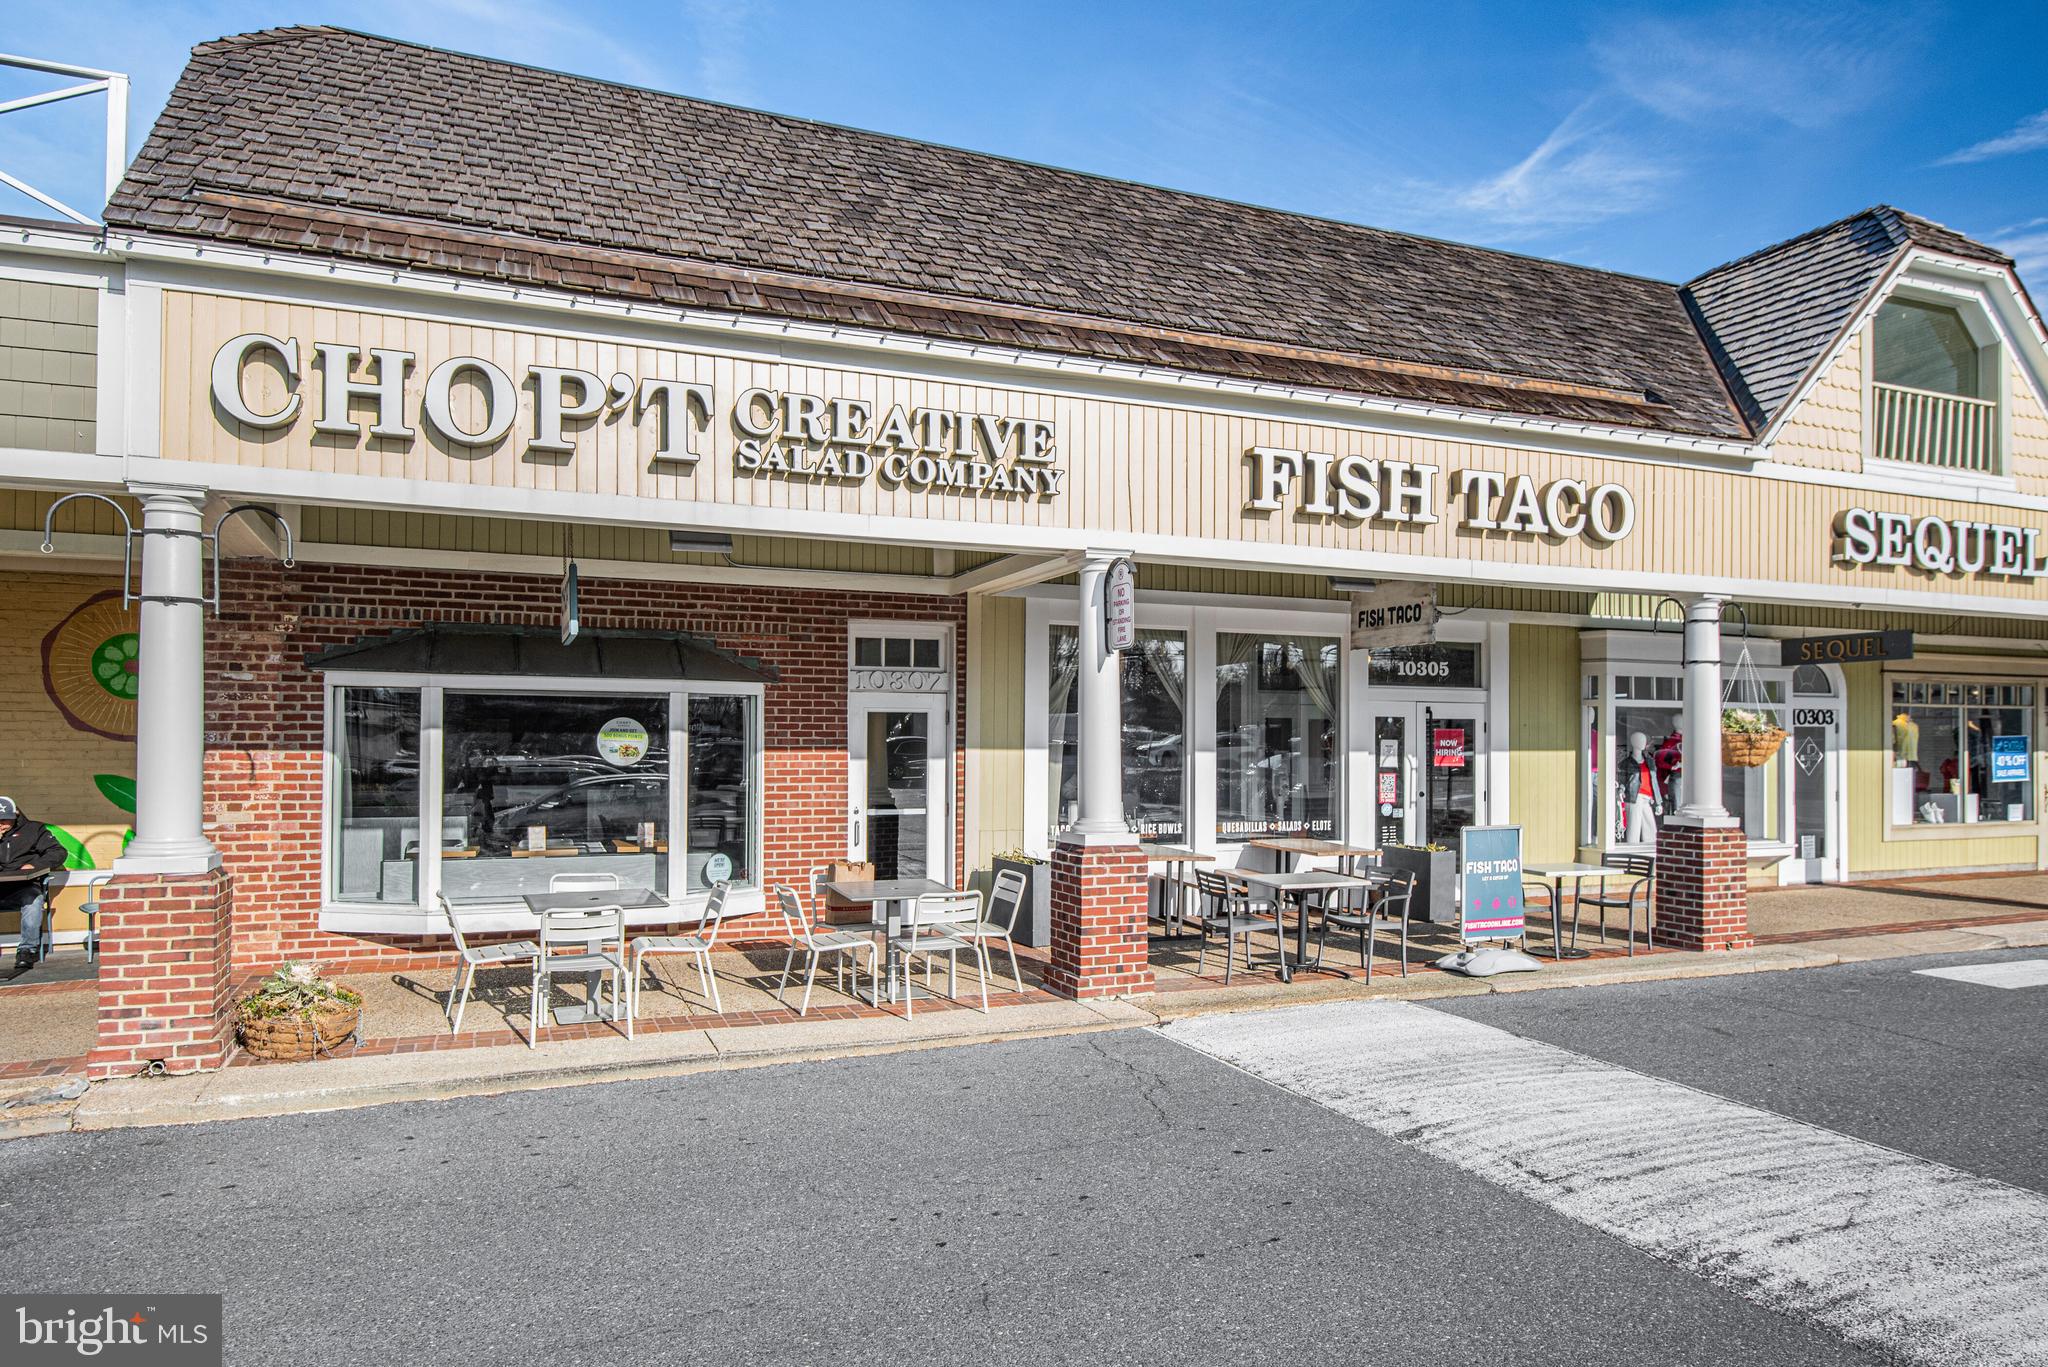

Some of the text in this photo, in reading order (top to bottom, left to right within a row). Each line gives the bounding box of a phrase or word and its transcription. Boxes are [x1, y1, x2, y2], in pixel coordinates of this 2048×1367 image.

[211, 333, 714, 464] CHOP'T
[734, 387, 1057, 464] CREATIVE
[736, 439, 1066, 496] SALAD COMPANY
[1243, 446, 1636, 542] FISH TACO
[1833, 507, 2048, 577] SEQUEL
[1117, 588, 1125, 597] NO
[1113, 599, 1129, 607] PARKING
[1112, 616, 1131, 625] STANDING
[1358, 603, 1422, 628] FISH TACO
[1117, 634, 1127, 642] LANE
[1800, 636, 1888, 661] SEQUEL
[1397, 661, 1450, 677] 10305
[855, 670, 941, 691] 10307
[1793, 709, 1834, 725] 10303
[2012, 755, 2026, 766] OFF
[1140, 823, 1157, 834] RICE
[1158, 822, 1183, 834] BOWLS
[1222, 820, 1332, 833] QUESADILLAS SALADS ELOTE
[1466, 859, 1518, 874] FISH TACO
